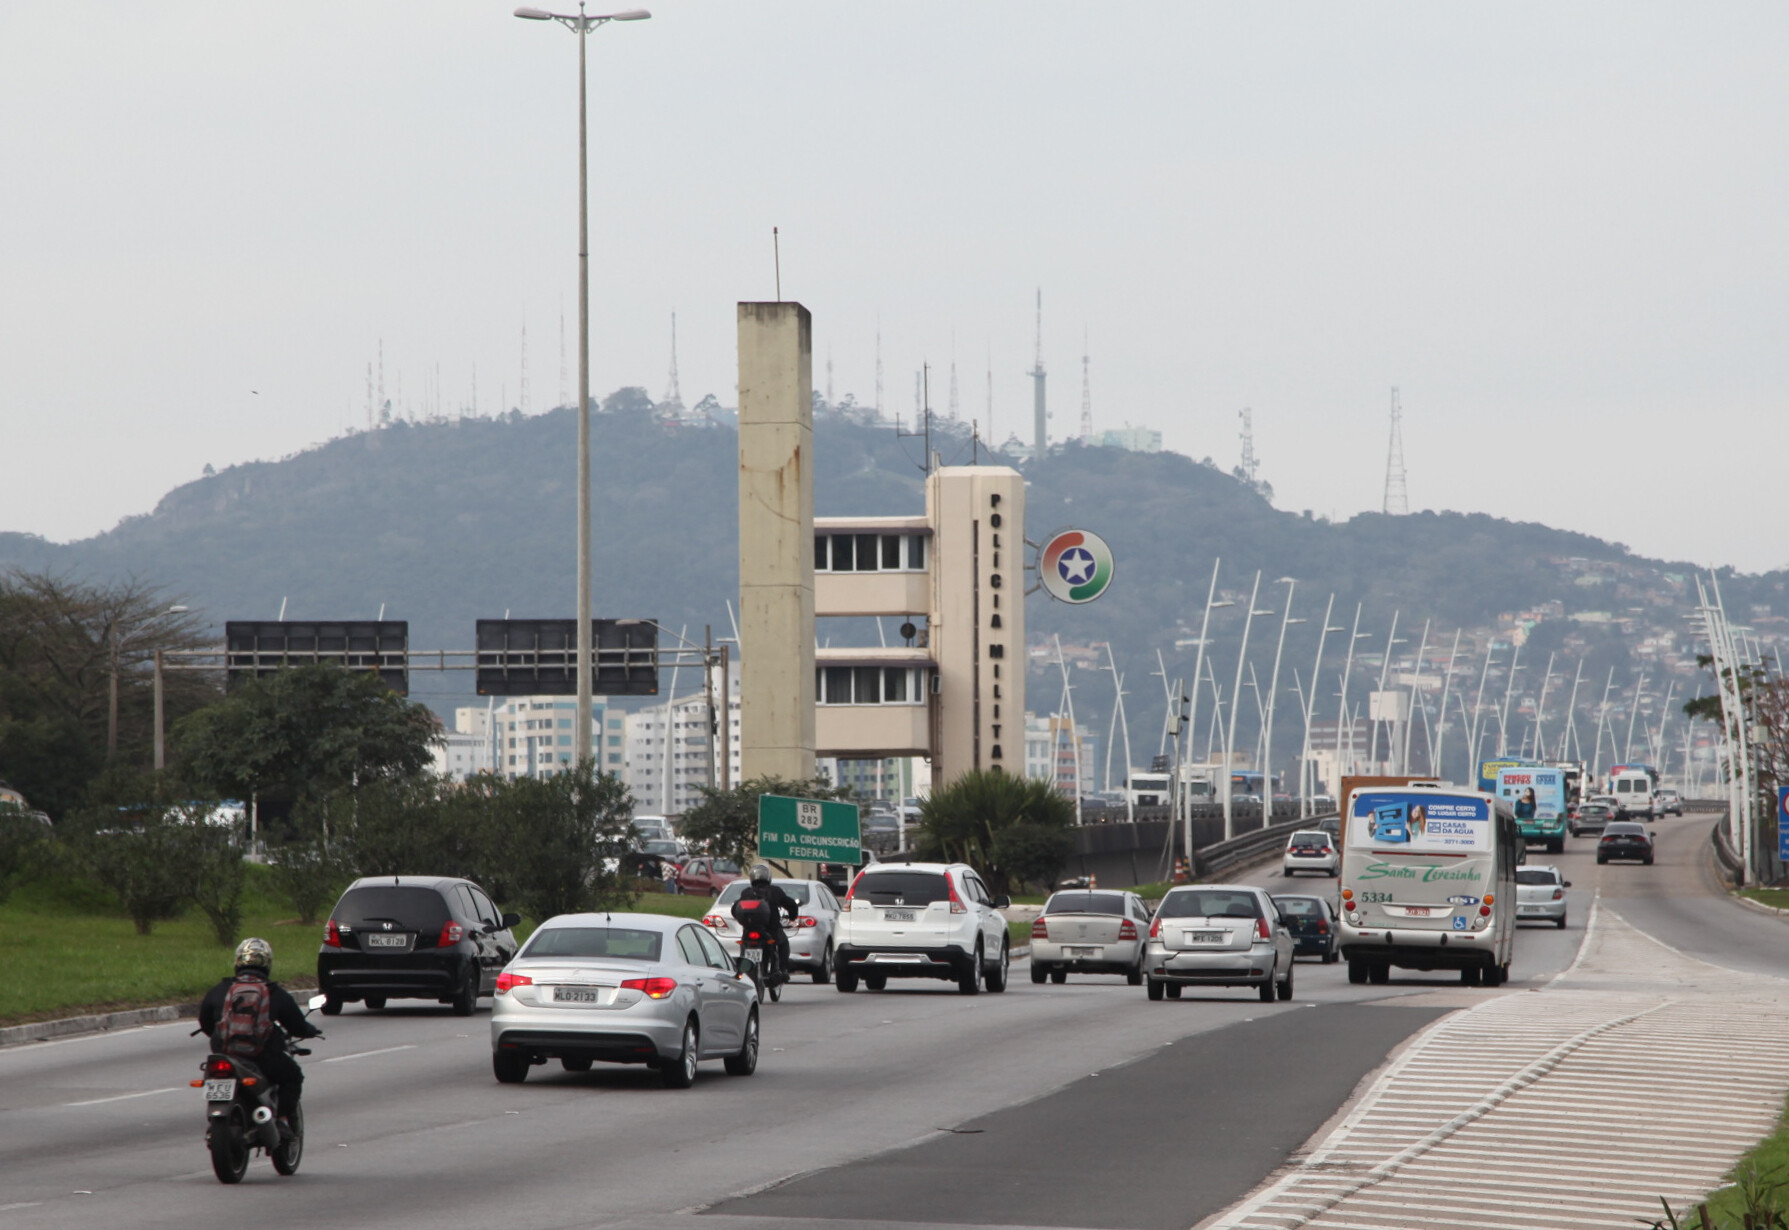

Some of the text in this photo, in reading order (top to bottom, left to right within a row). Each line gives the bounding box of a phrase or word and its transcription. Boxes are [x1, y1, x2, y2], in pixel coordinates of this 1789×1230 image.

[802, 804, 817, 814] BR
[801, 815, 819, 826] 282
[762, 832, 859, 848] FIM DA CIRCUNSCRIÇÃO
[789, 847, 830, 859] FEDERAL
[1357, 862, 1482, 883] Santa Terezinha
[1361, 892, 1393, 903] 5334
